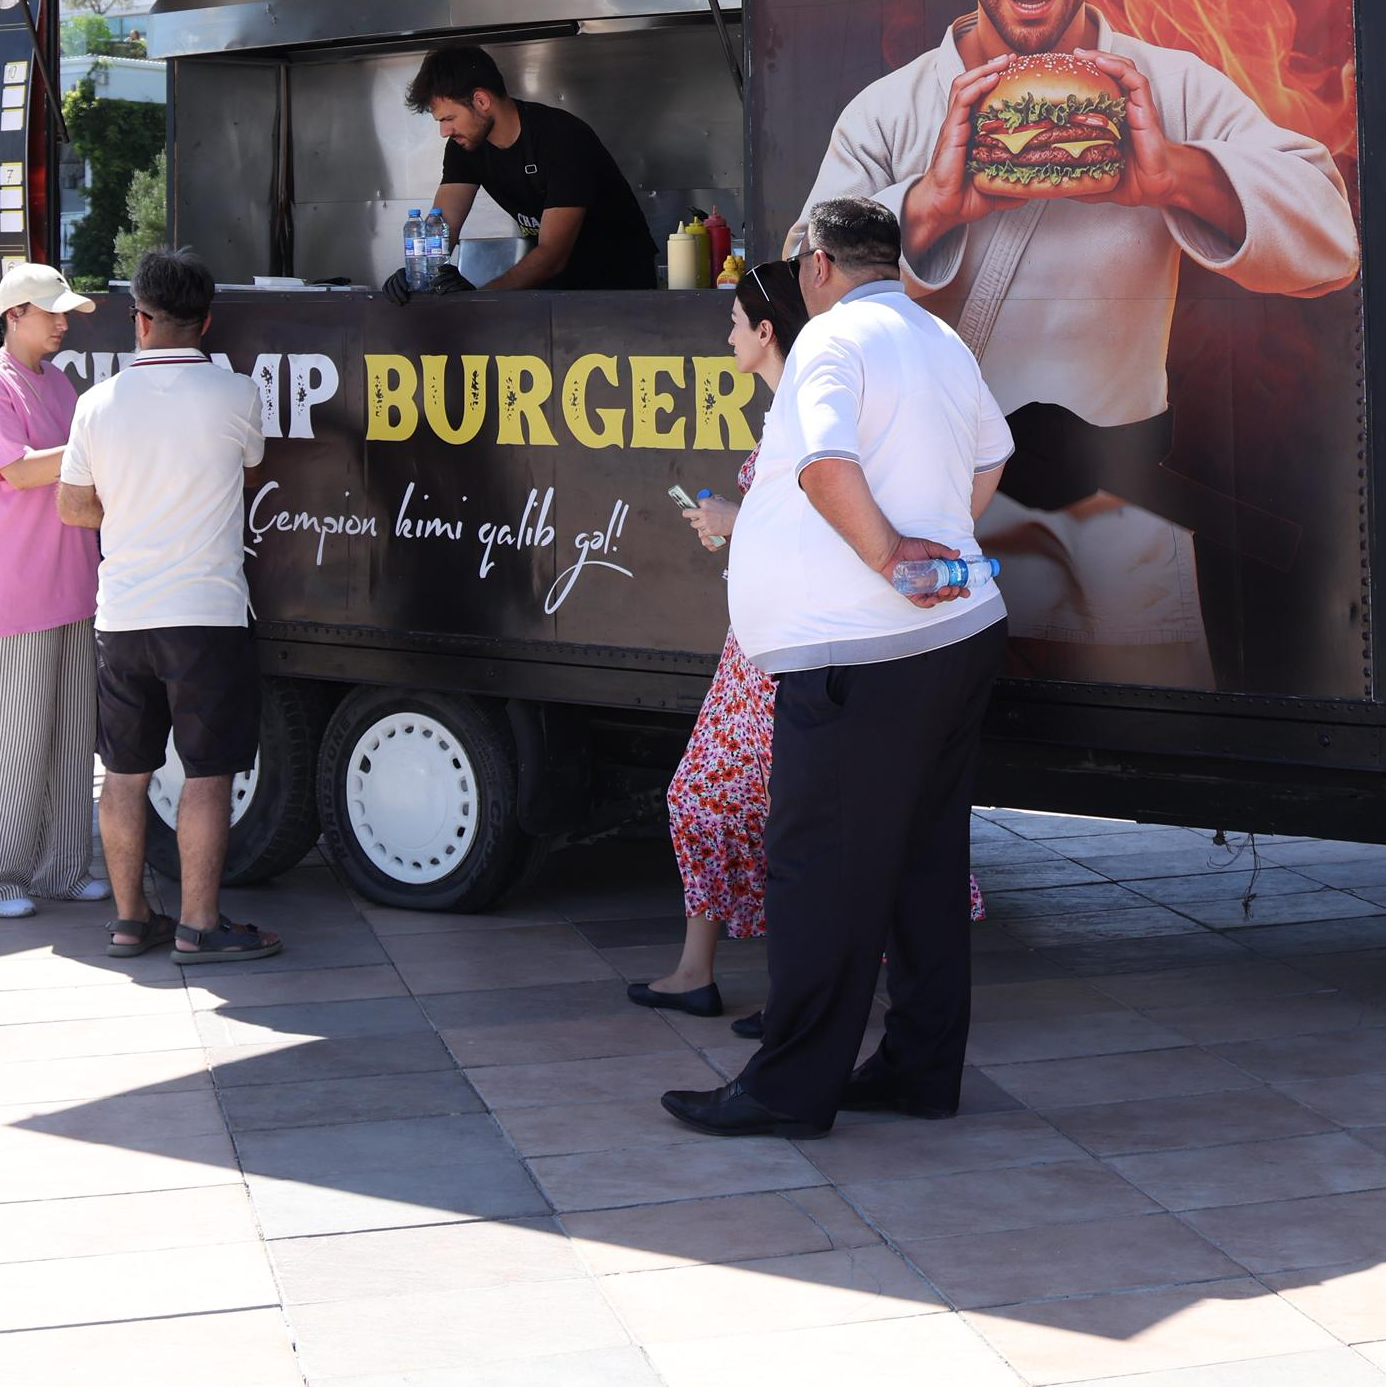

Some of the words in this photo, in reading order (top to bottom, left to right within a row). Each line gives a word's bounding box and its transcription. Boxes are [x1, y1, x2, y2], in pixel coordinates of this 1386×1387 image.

[364, 353, 759, 450] BURGER
[249, 481, 377, 566] Çempion
[395, 481, 463, 541] kimi
[479, 486, 556, 579] qalib
